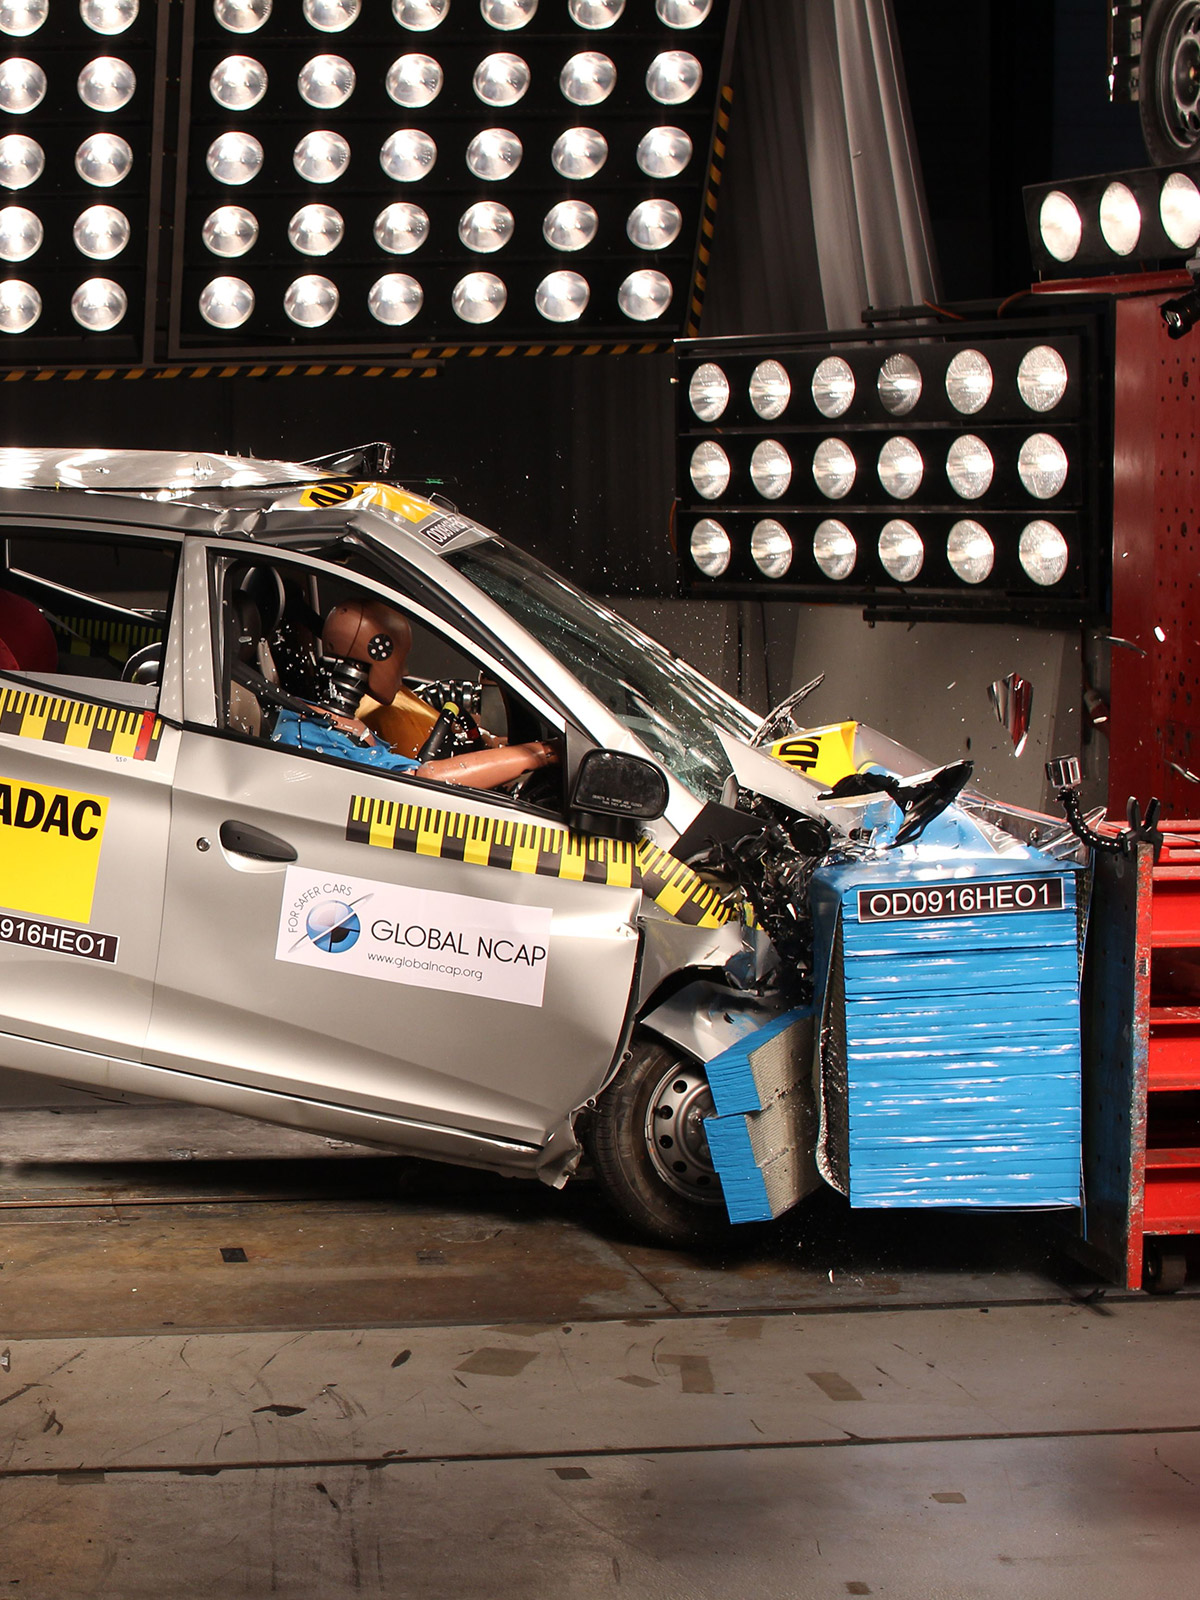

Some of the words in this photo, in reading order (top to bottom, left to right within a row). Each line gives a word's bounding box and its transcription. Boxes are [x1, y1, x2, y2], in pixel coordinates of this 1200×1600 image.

[293, 886, 321, 910] SAFER
[322, 883, 352, 896] CARS
[869, 884, 1050, 917] OD0916HEO1
[288, 910, 300, 933] FOR
[371, 919, 469, 956] GLOBAL
[477, 937, 547, 967] NCAP
[367, 952, 483, 981] www.globalncap.org
